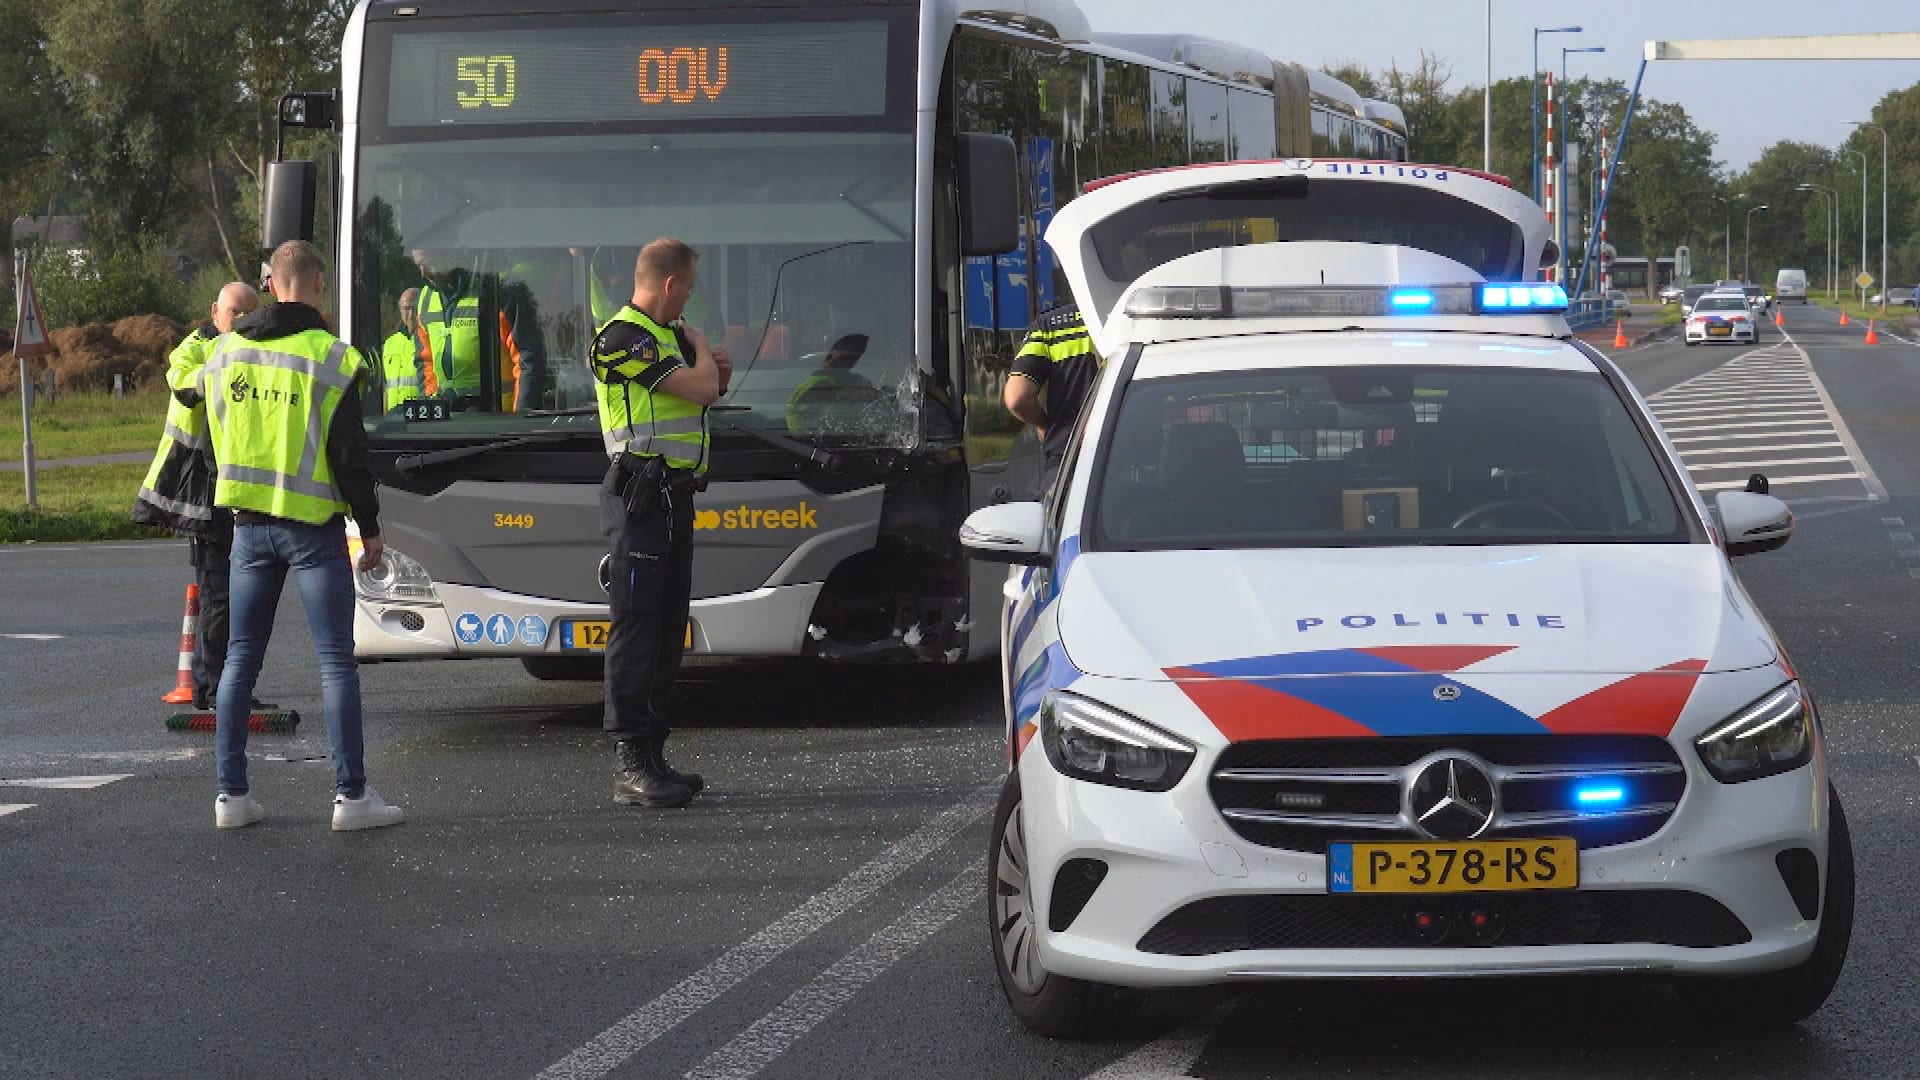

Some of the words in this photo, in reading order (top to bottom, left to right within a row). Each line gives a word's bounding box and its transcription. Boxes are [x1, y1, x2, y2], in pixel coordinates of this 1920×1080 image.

[457, 55, 515, 108] 50
[1326, 163, 1448, 182] POLITIE
[252, 387, 299, 406] LITIE
[494, 513, 534, 529] 3449
[723, 502, 818, 530] streek
[1296, 611, 1565, 633] POLITIE
[1333, 872, 1350, 885] NL
[1369, 845, 1557, 885] P-378-RS
